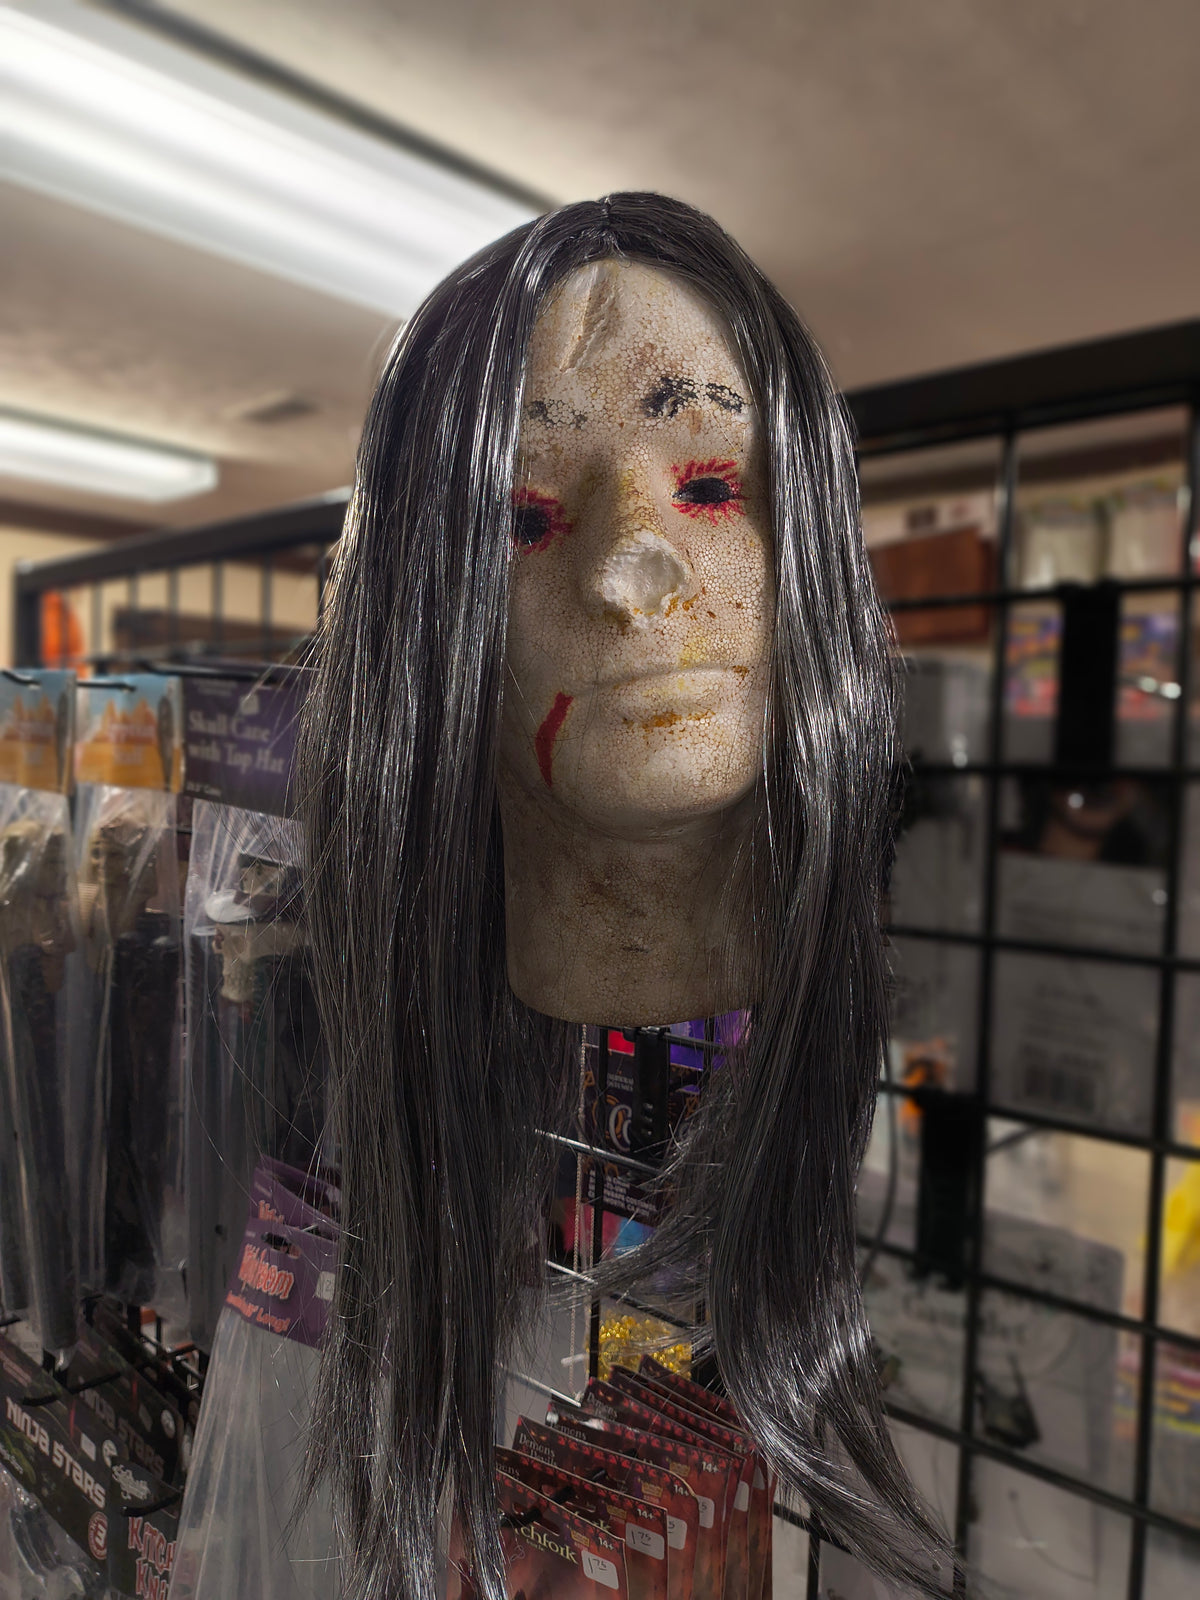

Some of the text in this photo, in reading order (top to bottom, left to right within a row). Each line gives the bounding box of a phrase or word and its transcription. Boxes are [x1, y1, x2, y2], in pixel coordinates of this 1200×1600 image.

[189, 710, 271, 742] Skull Cane
[188, 740, 285, 775] with Top Hat
[256, 1307, 291, 1333] Long!
[519, 1431, 556, 1458] Demons
[702, 1461, 720, 1473] 14+
[673, 1484, 690, 1497] 14+
[636, 1508, 655, 1520] 14+
[598, 1536, 614, 1551] 14+
